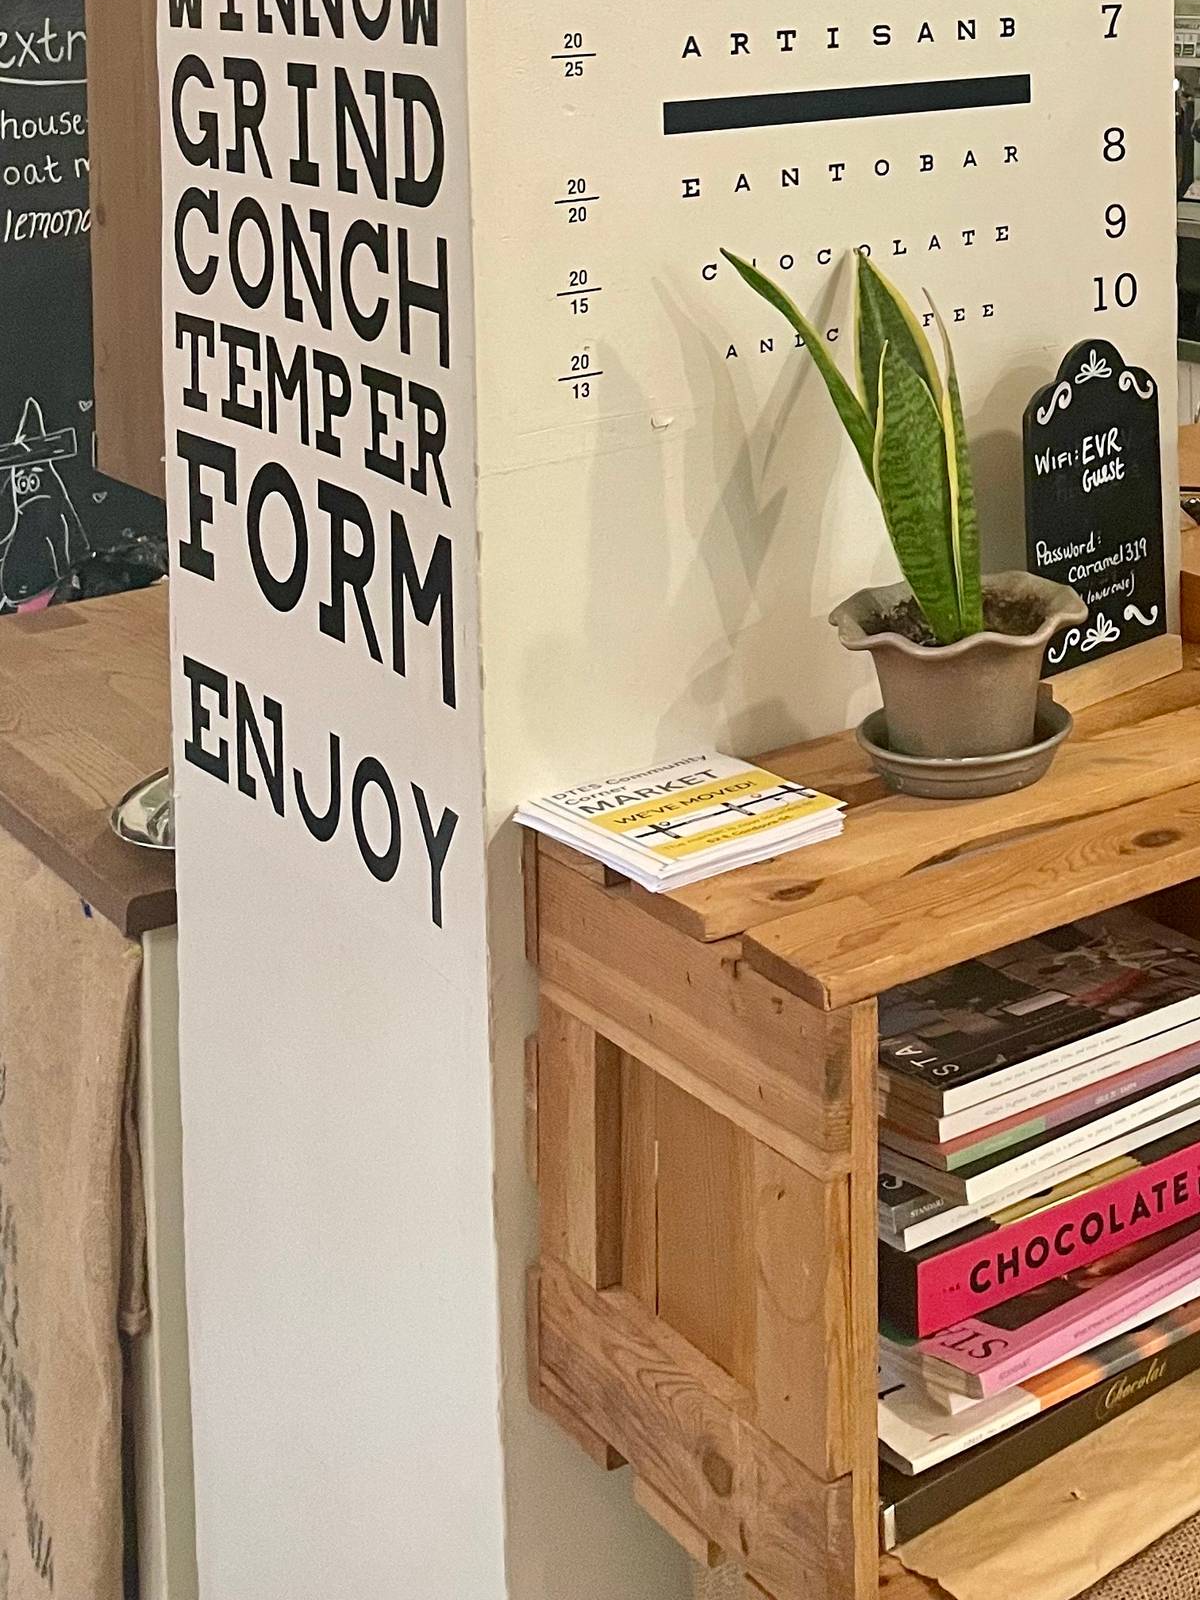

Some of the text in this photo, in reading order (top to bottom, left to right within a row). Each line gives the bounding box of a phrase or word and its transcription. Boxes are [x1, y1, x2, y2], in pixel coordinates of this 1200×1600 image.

[1101, 3, 1122, 39] 7
[563, 32, 583, 49] 20
[564, 60, 584, 78] 25
[172, 53, 445, 209] GRIND
[1102, 127, 1126, 162] 8
[3, 154, 63, 186] oat
[567, 178, 586, 195] 20
[568, 206, 587, 224] 20
[1104, 203, 1126, 238] 9
[175, 186, 450, 370] CONCH
[569, 269, 588, 287] 20
[1093, 272, 1138, 312] 10
[570, 297, 589, 315] 15
[570, 353, 590, 372] 20
[572, 382, 590, 399] 13
[175, 311, 452, 509] TEMPER
[1081, 425, 1123, 466] EVR
[177, 428, 457, 710] FORM
[183, 654, 460, 929] ENJOY
[551, 754, 707, 801] DTES Community
[577, 768, 718, 815] MARKET
[564, 785, 627, 806] Corner
[969, 1170, 1189, 1294] CHOCOLATE
